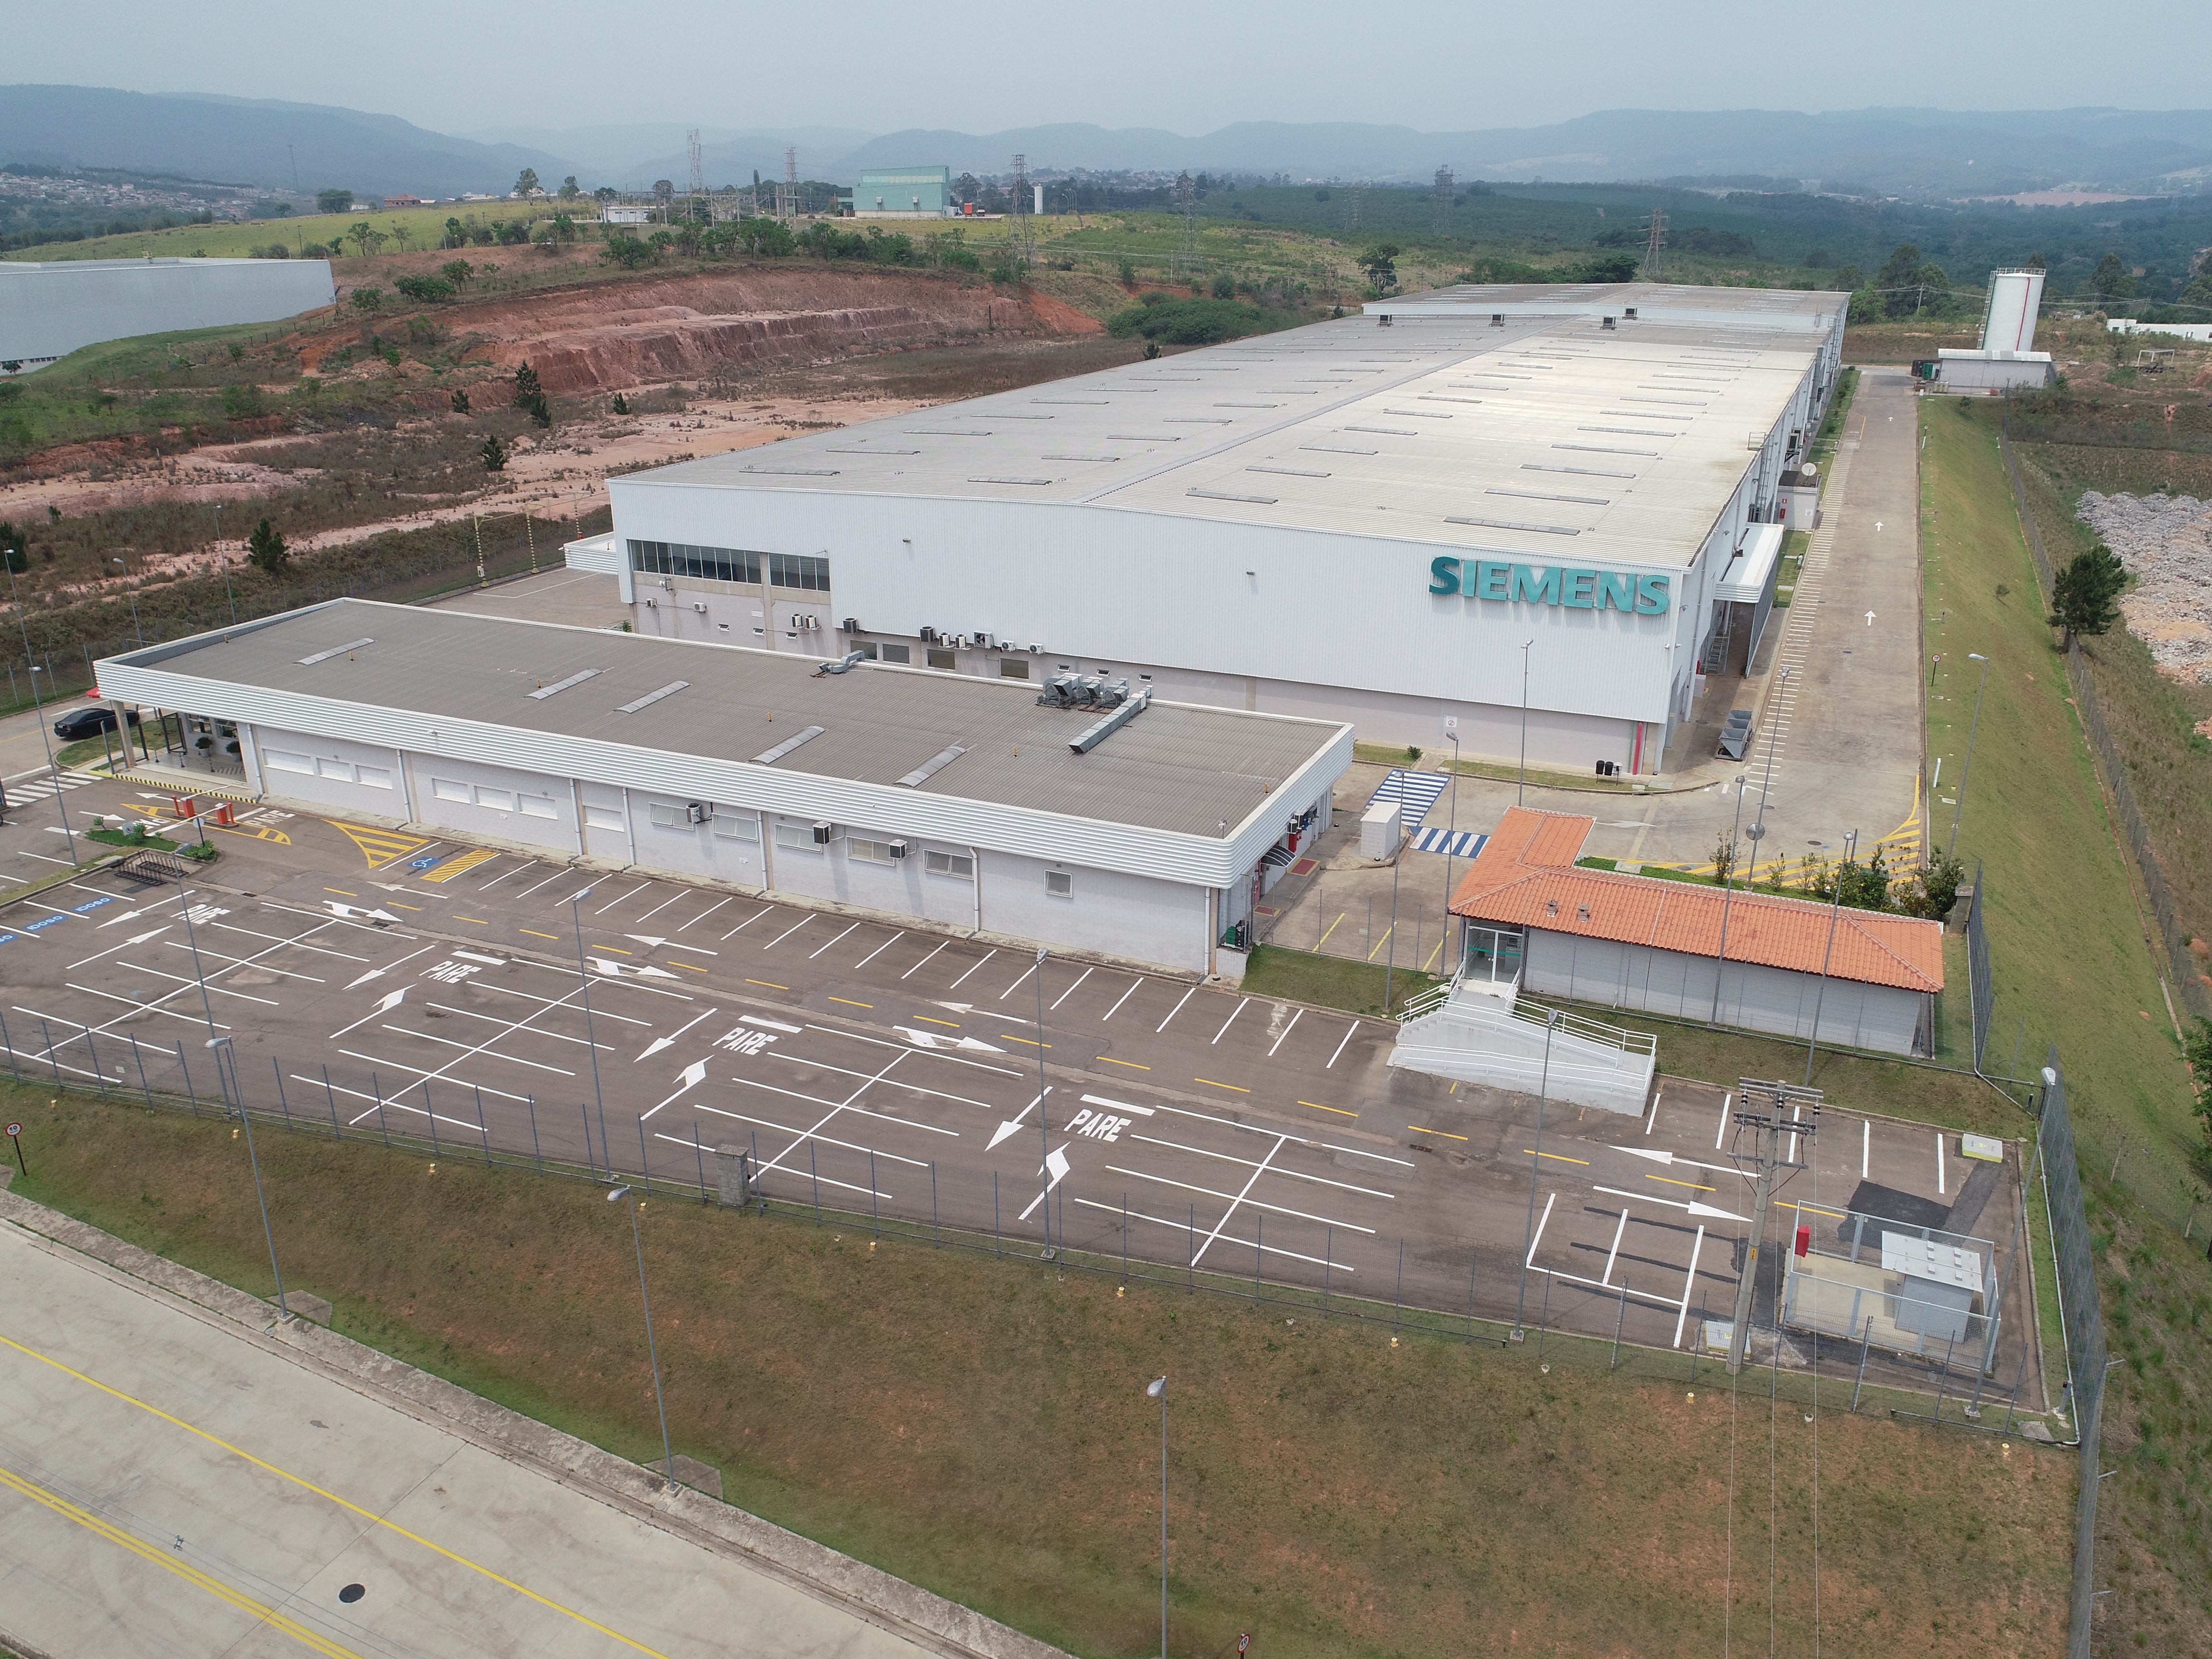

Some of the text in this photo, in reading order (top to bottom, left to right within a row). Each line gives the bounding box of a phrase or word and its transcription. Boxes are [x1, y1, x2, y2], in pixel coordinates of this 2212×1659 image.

[1429, 556, 1669, 614] SIEMENS
[244, 810, 296, 827] PARE
[75, 898, 110, 912] IDOSO
[170, 904, 231, 924] PARE
[26, 915, 63, 930] IDOSO
[418, 960, 483, 984] PARE
[711, 1027, 779, 1056] PARE
[1063, 1109, 1132, 1142] PARE
[1241, 1638, 1247, 1646] 10
